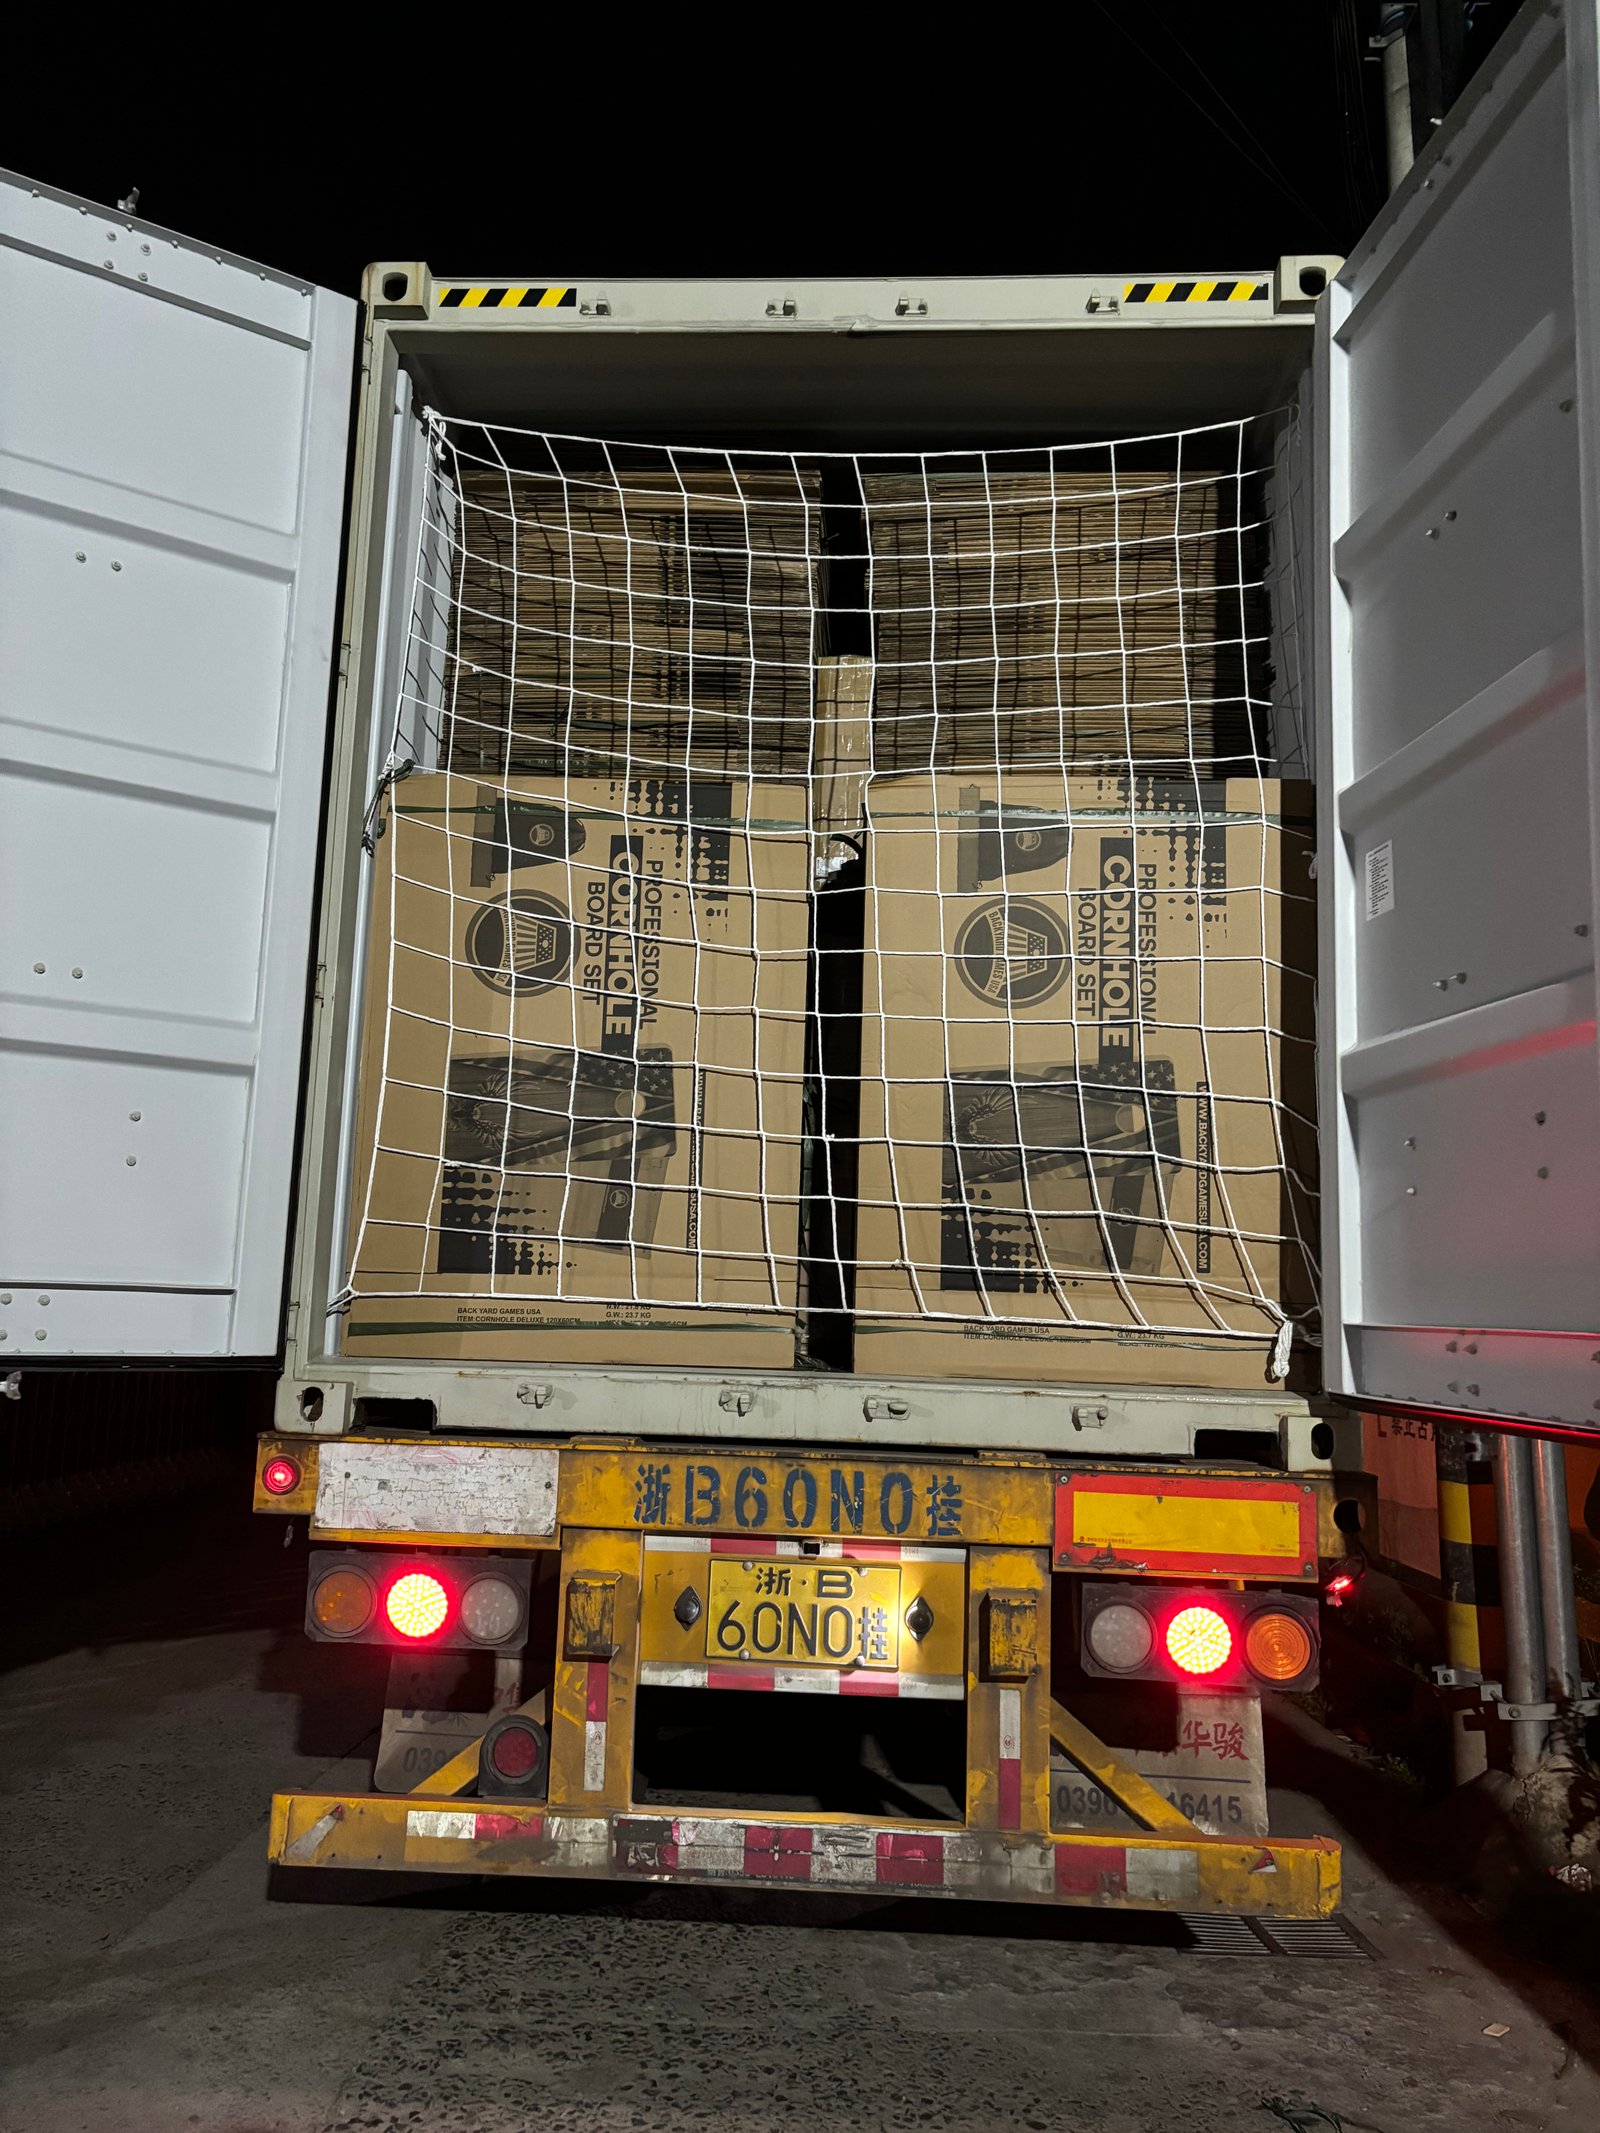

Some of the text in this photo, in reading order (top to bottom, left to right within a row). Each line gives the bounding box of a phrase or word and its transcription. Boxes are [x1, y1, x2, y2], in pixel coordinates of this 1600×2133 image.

[582, 881, 606, 1006] BOARD SET
[605, 851, 640, 1036] CORNHOLE
[1076, 887, 1097, 1017] BOARD SET
[1102, 855, 1132, 1048] CORNHOLE
[479, 1307, 498, 1315] YARD
[526, 1308, 542, 1316] USA
[605, 1311, 624, 1319] G.W.:
[963, 1324, 985, 1332] BACK
[1006, 1326, 1034, 1334] GAMES
[1034, 1327, 1051, 1335] USA
